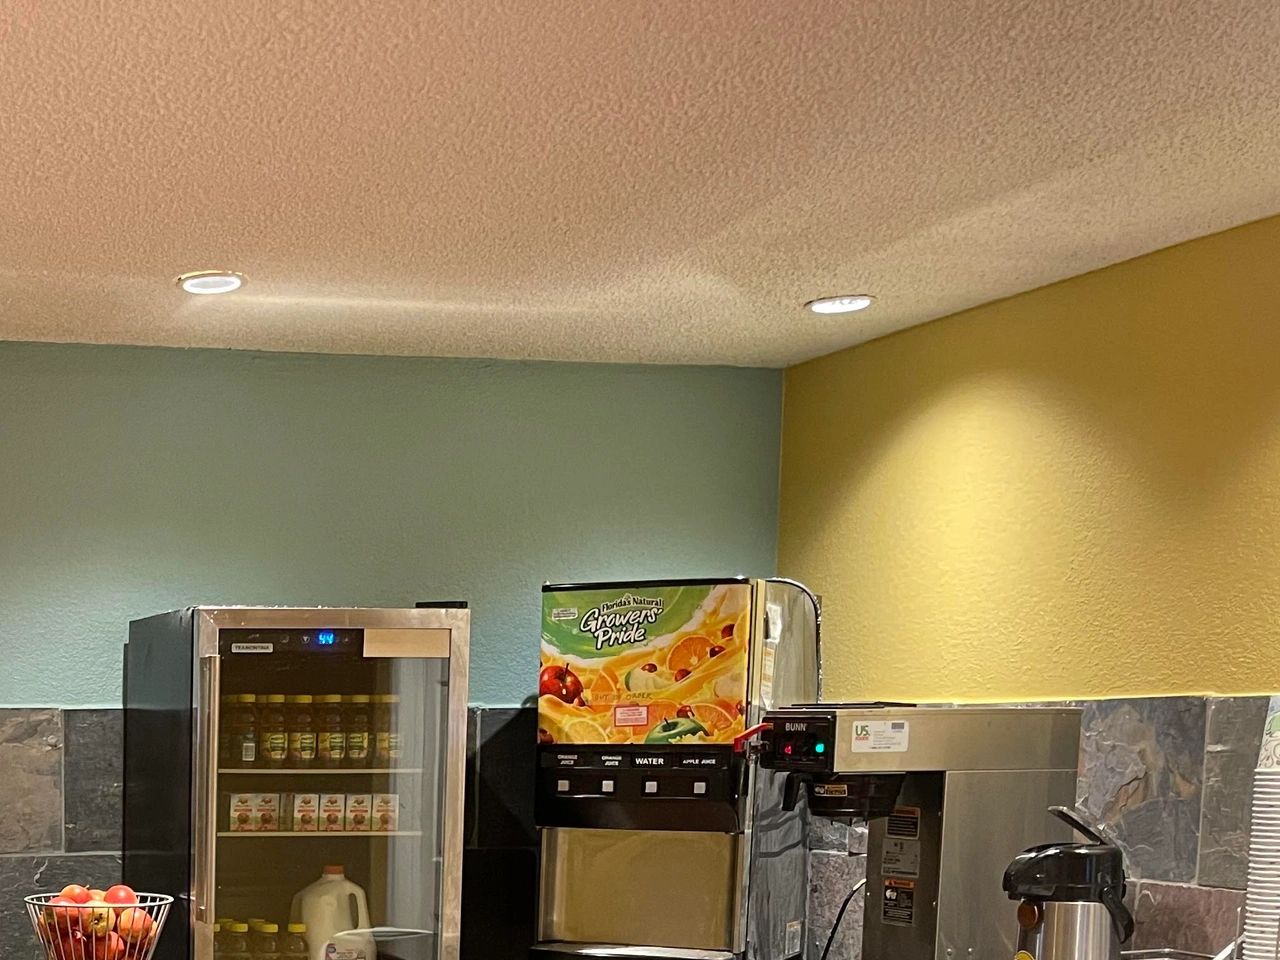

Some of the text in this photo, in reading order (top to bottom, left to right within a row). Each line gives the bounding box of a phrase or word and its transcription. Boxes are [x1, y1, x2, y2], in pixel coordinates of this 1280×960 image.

[632, 597, 662, 608] Natural
[581, 607, 664, 634] Growers'
[594, 625, 646, 650] Pride
[785, 722, 807, 732] BUNN
[635, 757, 664, 766] WATER
